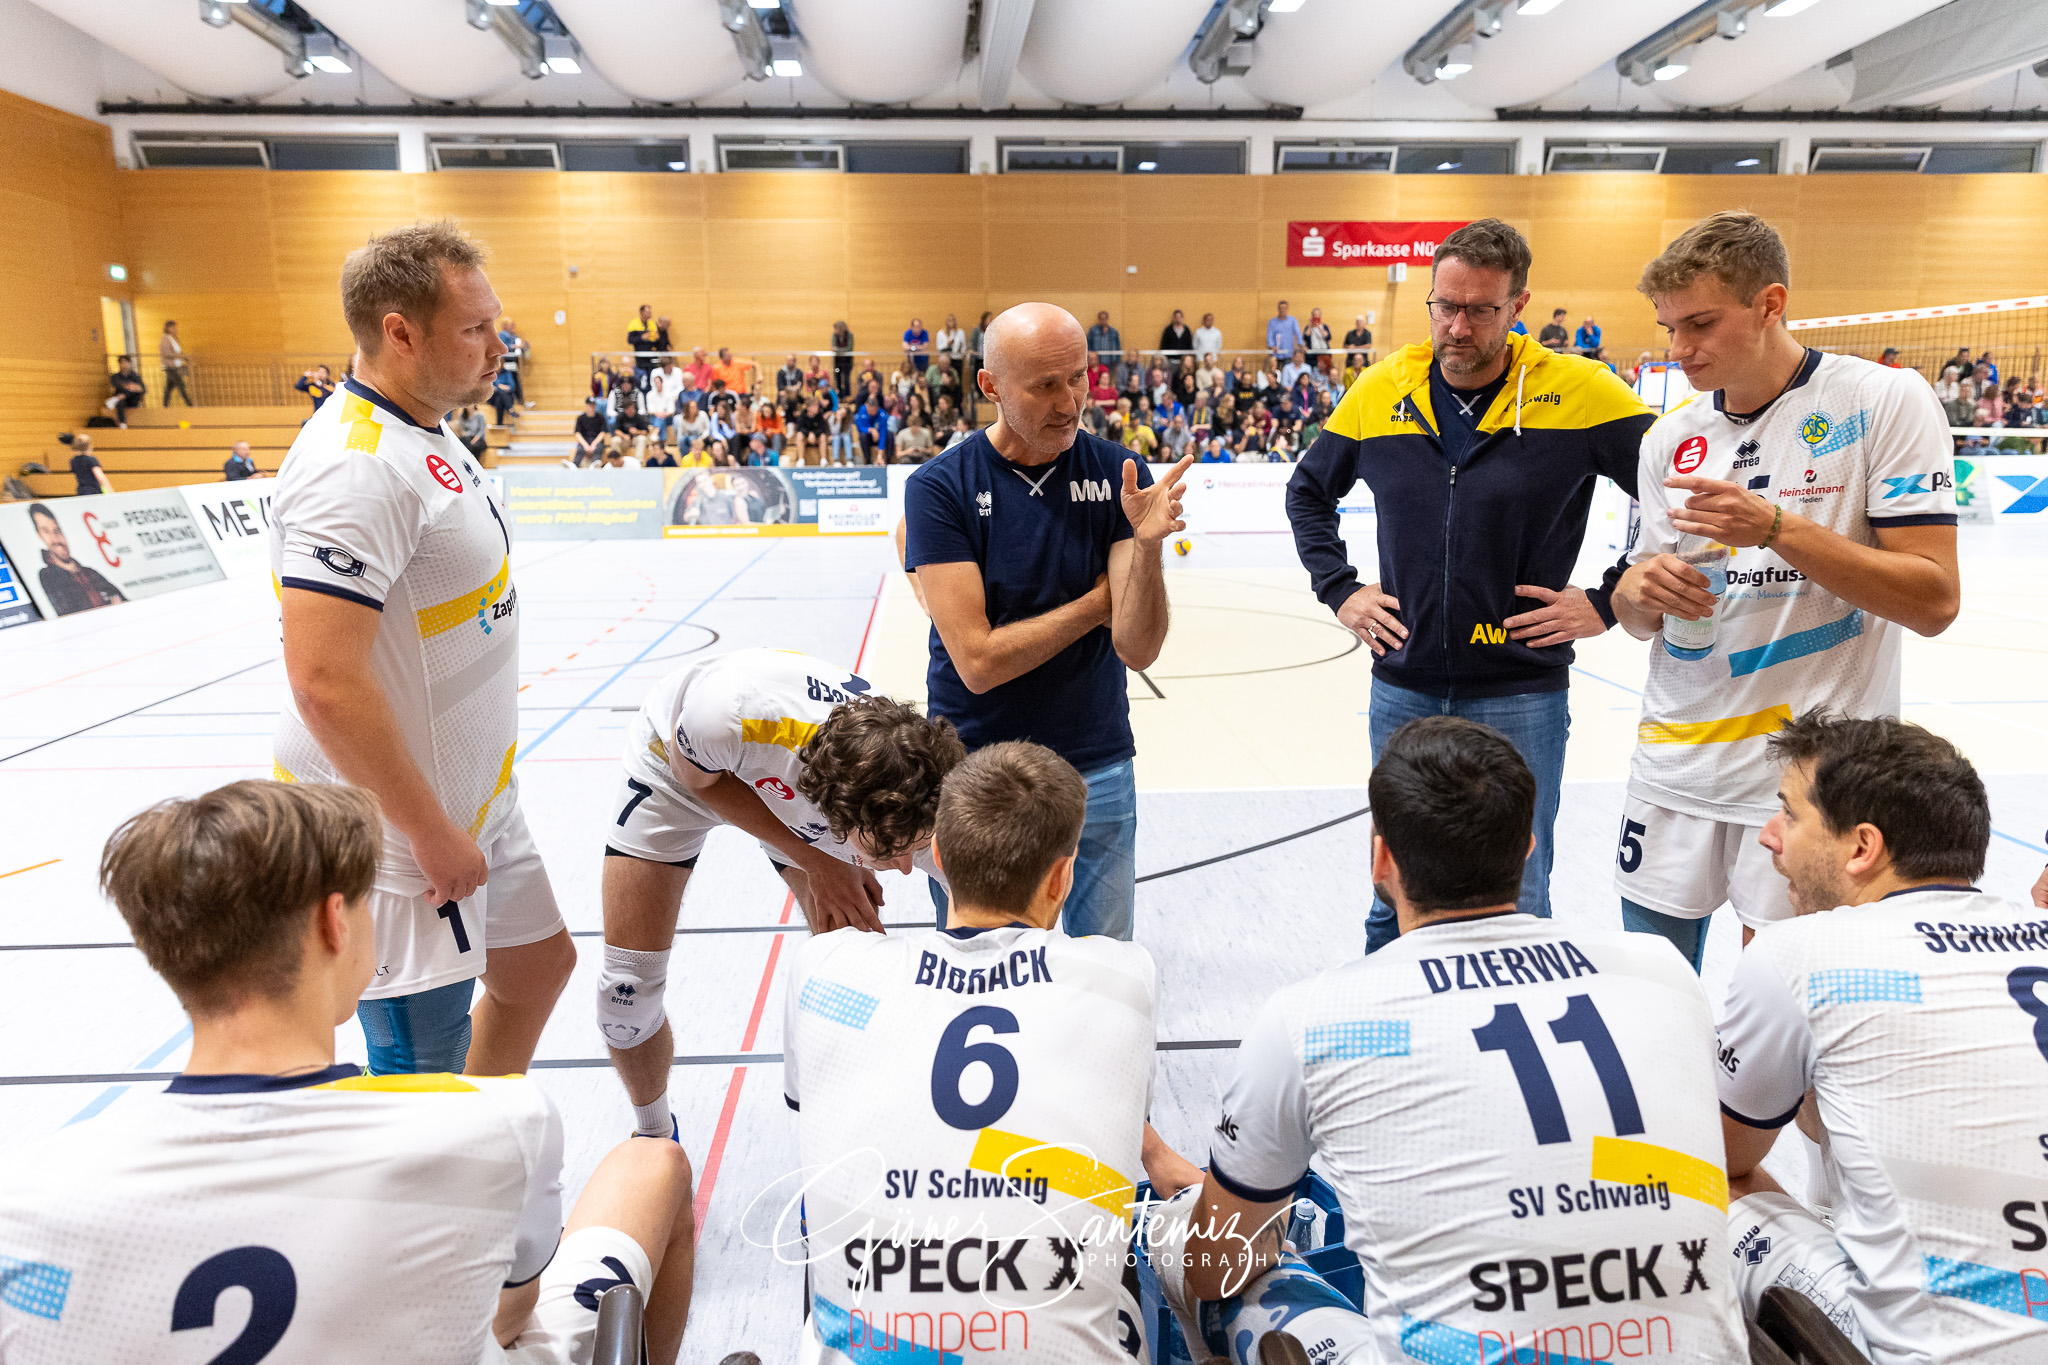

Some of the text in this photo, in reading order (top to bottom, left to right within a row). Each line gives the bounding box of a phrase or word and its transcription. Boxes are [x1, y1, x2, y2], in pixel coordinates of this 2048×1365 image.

[1332, 240, 1436, 260] Sparkasse Nür
[1733, 456, 1760, 470] errea
[1069, 478, 1112, 502] MM
[1779, 485, 1845, 498] Heinzelmann
[1799, 496, 1824, 504] Medien
[124, 506, 188, 526] PERSONAL
[137, 525, 197, 547] TRAINING
[1470, 623, 1507, 644] AW
[617, 776, 653, 827] 7
[437, 899, 472, 954] 1
[915, 945, 1053, 995] BIBRACK
[1420, 940, 1598, 994] DZIERWA
[611, 996, 634, 1006] errea
[931, 1005, 1020, 1131] 6
[1471, 993, 1646, 1146] 11
[885, 1167, 1049, 1205] SV Schwaig
[1507, 1174, 1671, 1219] SV Schwaig
[845, 1236, 1029, 1294] SPECK
[1468, 1244, 1668, 1313] SPECK
[171, 1245, 298, 1365] 2
[850, 1308, 1029, 1365] pumpen
[1307, 1337, 1336, 1360] erre
